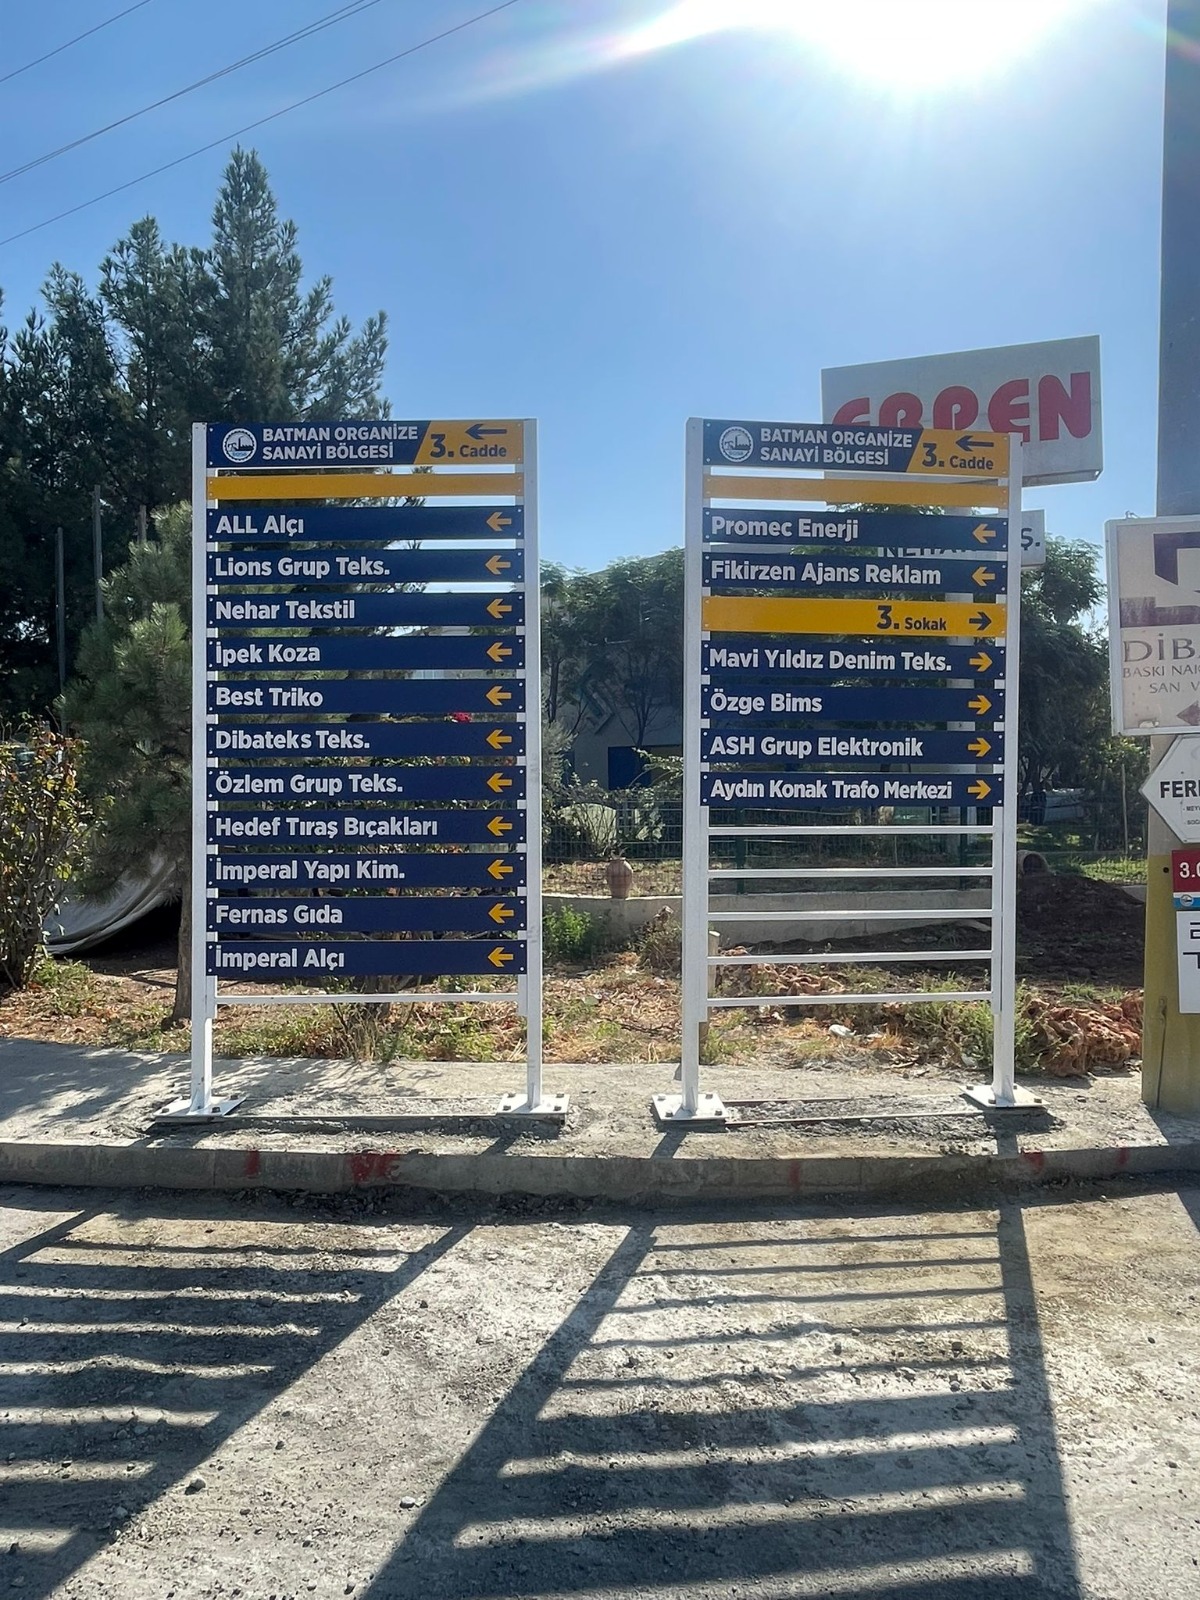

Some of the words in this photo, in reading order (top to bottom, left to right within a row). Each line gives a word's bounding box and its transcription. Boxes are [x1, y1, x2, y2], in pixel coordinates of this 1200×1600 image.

[263, 428, 330, 441] BATMAN
[335, 423, 418, 440] ORGANİZE
[761, 428, 827, 444] BATMAN
[832, 430, 912, 447] ORGANİZE
[263, 443, 321, 460] SANAYİ
[326, 442, 393, 459] BÖLGESİ
[430, 434, 454, 458] 3.
[460, 444, 507, 457] Cadde
[761, 446, 818, 462] SANAYİ
[824, 447, 888, 465] BÖLGESİ
[922, 443, 945, 467] 3.
[950, 455, 993, 470] Cadde
[216, 516, 257, 533] ALL
[263, 515, 303, 536] Alçı
[712, 516, 792, 536] Promec
[799, 519, 858, 541] Enerji
[216, 557, 272, 576] Lions
[278, 558, 330, 578] Grup
[336, 557, 390, 575] Teks.
[712, 560, 795, 580] Fikirzen
[801, 563, 859, 584] Ajans
[866, 564, 940, 584] Reklam
[216, 601, 280, 619] Nehar
[286, 600, 354, 619] Tekstil
[877, 605, 899, 629] 3.
[905, 617, 946, 631] Sokak
[216, 642, 262, 667] İpek
[269, 644, 320, 662] Koza
[710, 649, 758, 667] Mavi
[765, 649, 823, 668] Yıldız
[830, 651, 895, 669] Denim
[901, 652, 951, 670] Teks.
[1123, 666, 1164, 678] BASKI
[216, 687, 263, 705] Best
[269, 688, 323, 706] Triko
[711, 688, 765, 714] Özge
[771, 693, 822, 712] Bims
[216, 730, 311, 749] Dibateks
[316, 730, 369, 748] Teks.
[710, 736, 754, 754] ASH
[761, 737, 812, 758] Grup
[818, 737, 923, 756] Elektronik
[216, 771, 283, 793] Özlem
[290, 775, 342, 796] Grup
[349, 774, 402, 792] Teks.
[711, 779, 764, 800] Aydın
[770, 780, 827, 798] Konak
[832, 780, 879, 798] Trafo
[884, 781, 952, 799] Merkezi
[216, 817, 280, 836] Hedef
[286, 818, 338, 838] Tıraş
[345, 817, 437, 837] Bıçakları
[216, 858, 297, 883] İmperal
[304, 861, 349, 882] Yapı
[357, 860, 405, 878] Kim.
[216, 905, 287, 923] Fernas
[294, 905, 342, 923] Gıda
[216, 945, 297, 971] İmperal
[303, 949, 344, 970] Alçı
